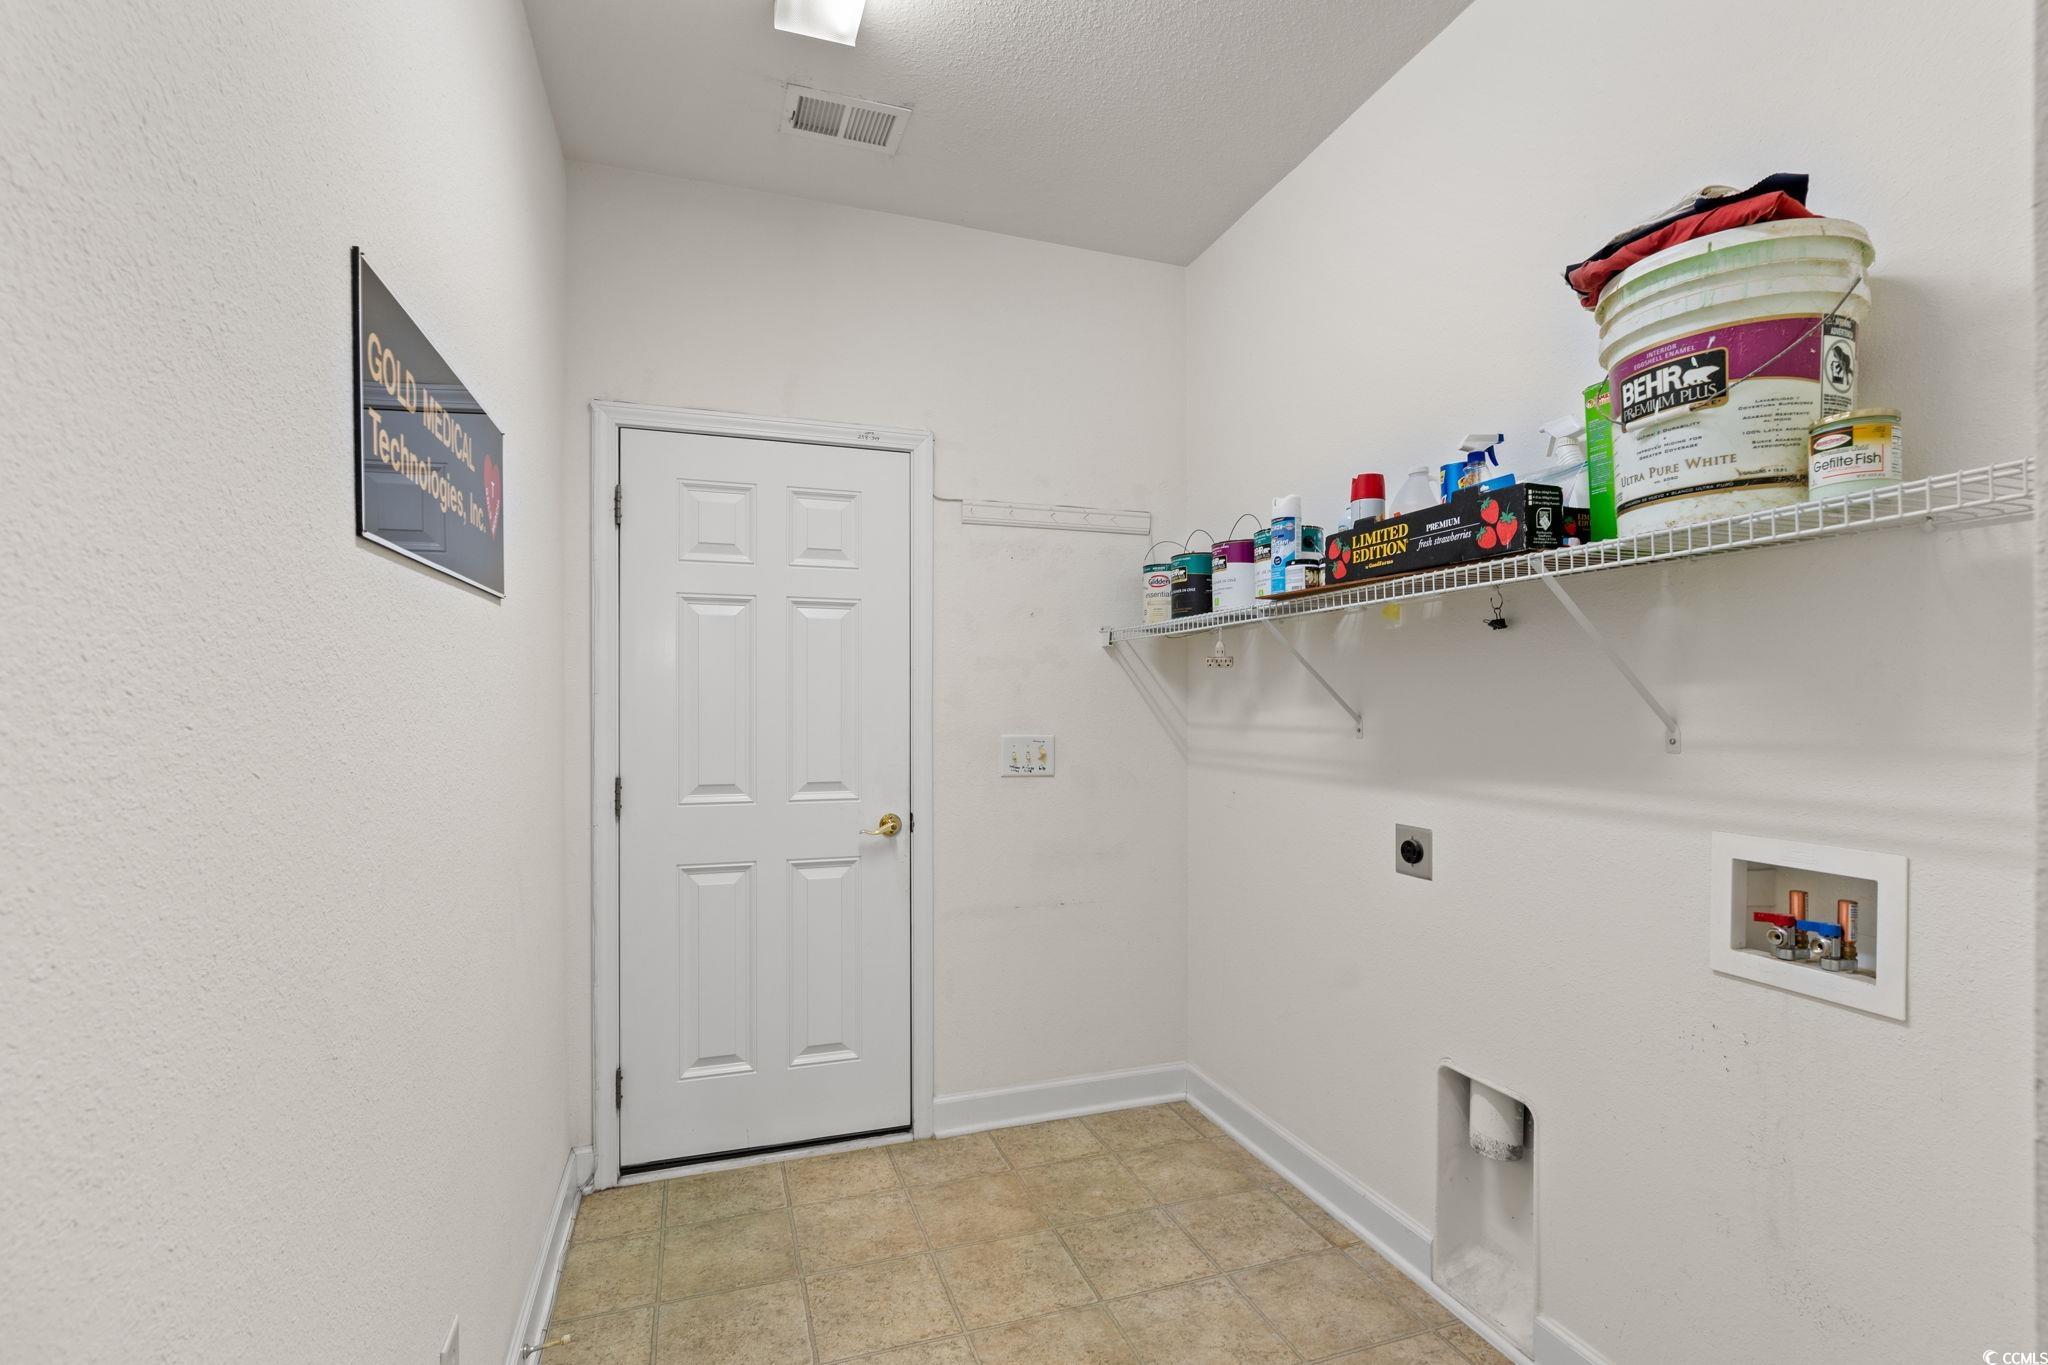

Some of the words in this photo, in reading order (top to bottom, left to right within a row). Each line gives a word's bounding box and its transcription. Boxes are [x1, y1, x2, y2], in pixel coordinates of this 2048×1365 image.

[1633, 355, 1663, 371] EGGSHELL
[1664, 345, 1696, 359] ENAMEL
[1646, 343, 1678, 359] INTERIOR
[1622, 364, 1683, 409] BEHR
[367, 332, 417, 414] GOLD
[422, 388, 475, 472] MEDICAL
[1623, 393, 1675, 421] PREMIUM
[1680, 383, 1717, 403] PLUS
[367, 406, 467, 525] Technologies,
[469, 492, 487, 533] Inc.
[1621, 472, 1645, 488] ULTRA
[1649, 463, 1680, 478] PURE
[1685, 453, 1737, 470] WHITE
[1814, 456, 1853, 472] Gefilte
[1855, 452, 1882, 465] Fish
[1352, 523, 1409, 549] LIMITED
[1425, 516, 1461, 532] PREMIUM
[1352, 539, 1408, 564] EDITION
[1416, 538, 1433, 551] fresh
[1433, 530, 1472, 546] strawberries
